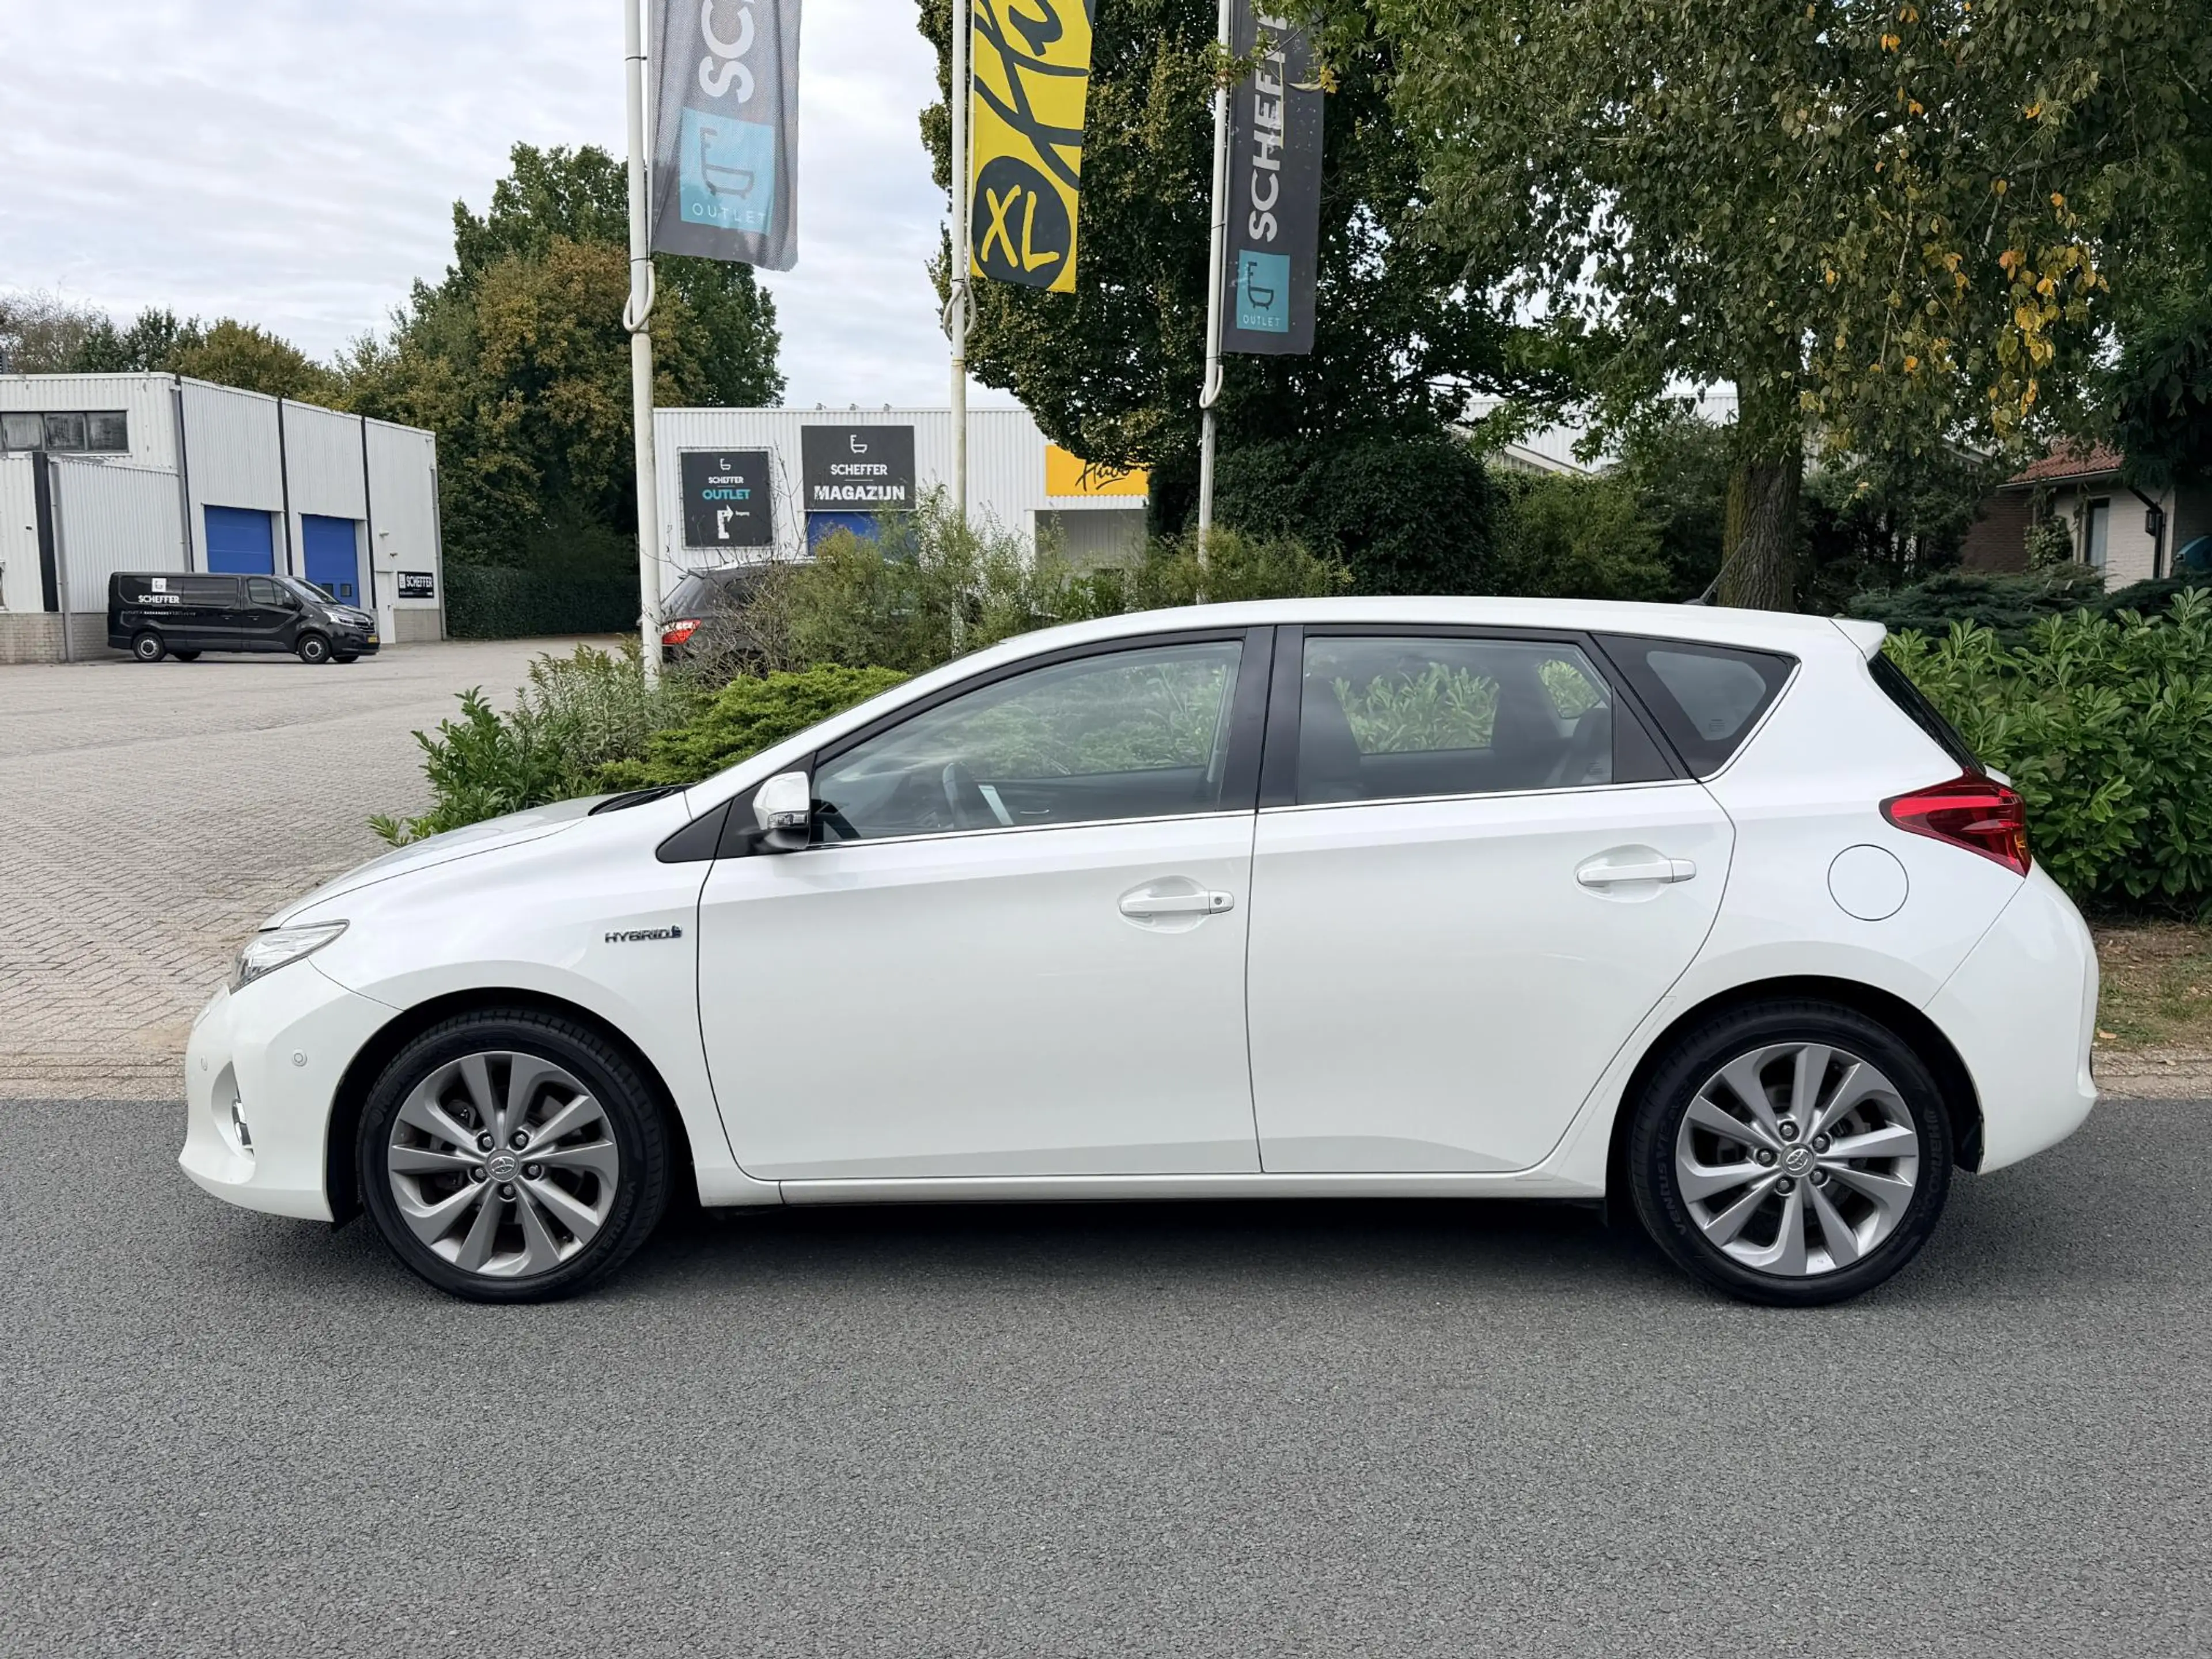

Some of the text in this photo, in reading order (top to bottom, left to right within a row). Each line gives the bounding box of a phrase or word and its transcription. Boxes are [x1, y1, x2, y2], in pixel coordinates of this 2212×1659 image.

[692, 202, 767, 226] OUTLET
[980, 184, 1060, 273] XL
[1243, 313, 1281, 328] OUTLET
[830, 463, 888, 476] SCHEFFER
[708, 476, 744, 484] SCHEFFER
[702, 488, 751, 500] OUTLET
[813, 485, 906, 501] MAGAZIJN
[406, 575, 433, 588] SCHEFFER
[138, 594, 180, 604] SCHEFFER
[605, 928, 669, 943] HYBRID
